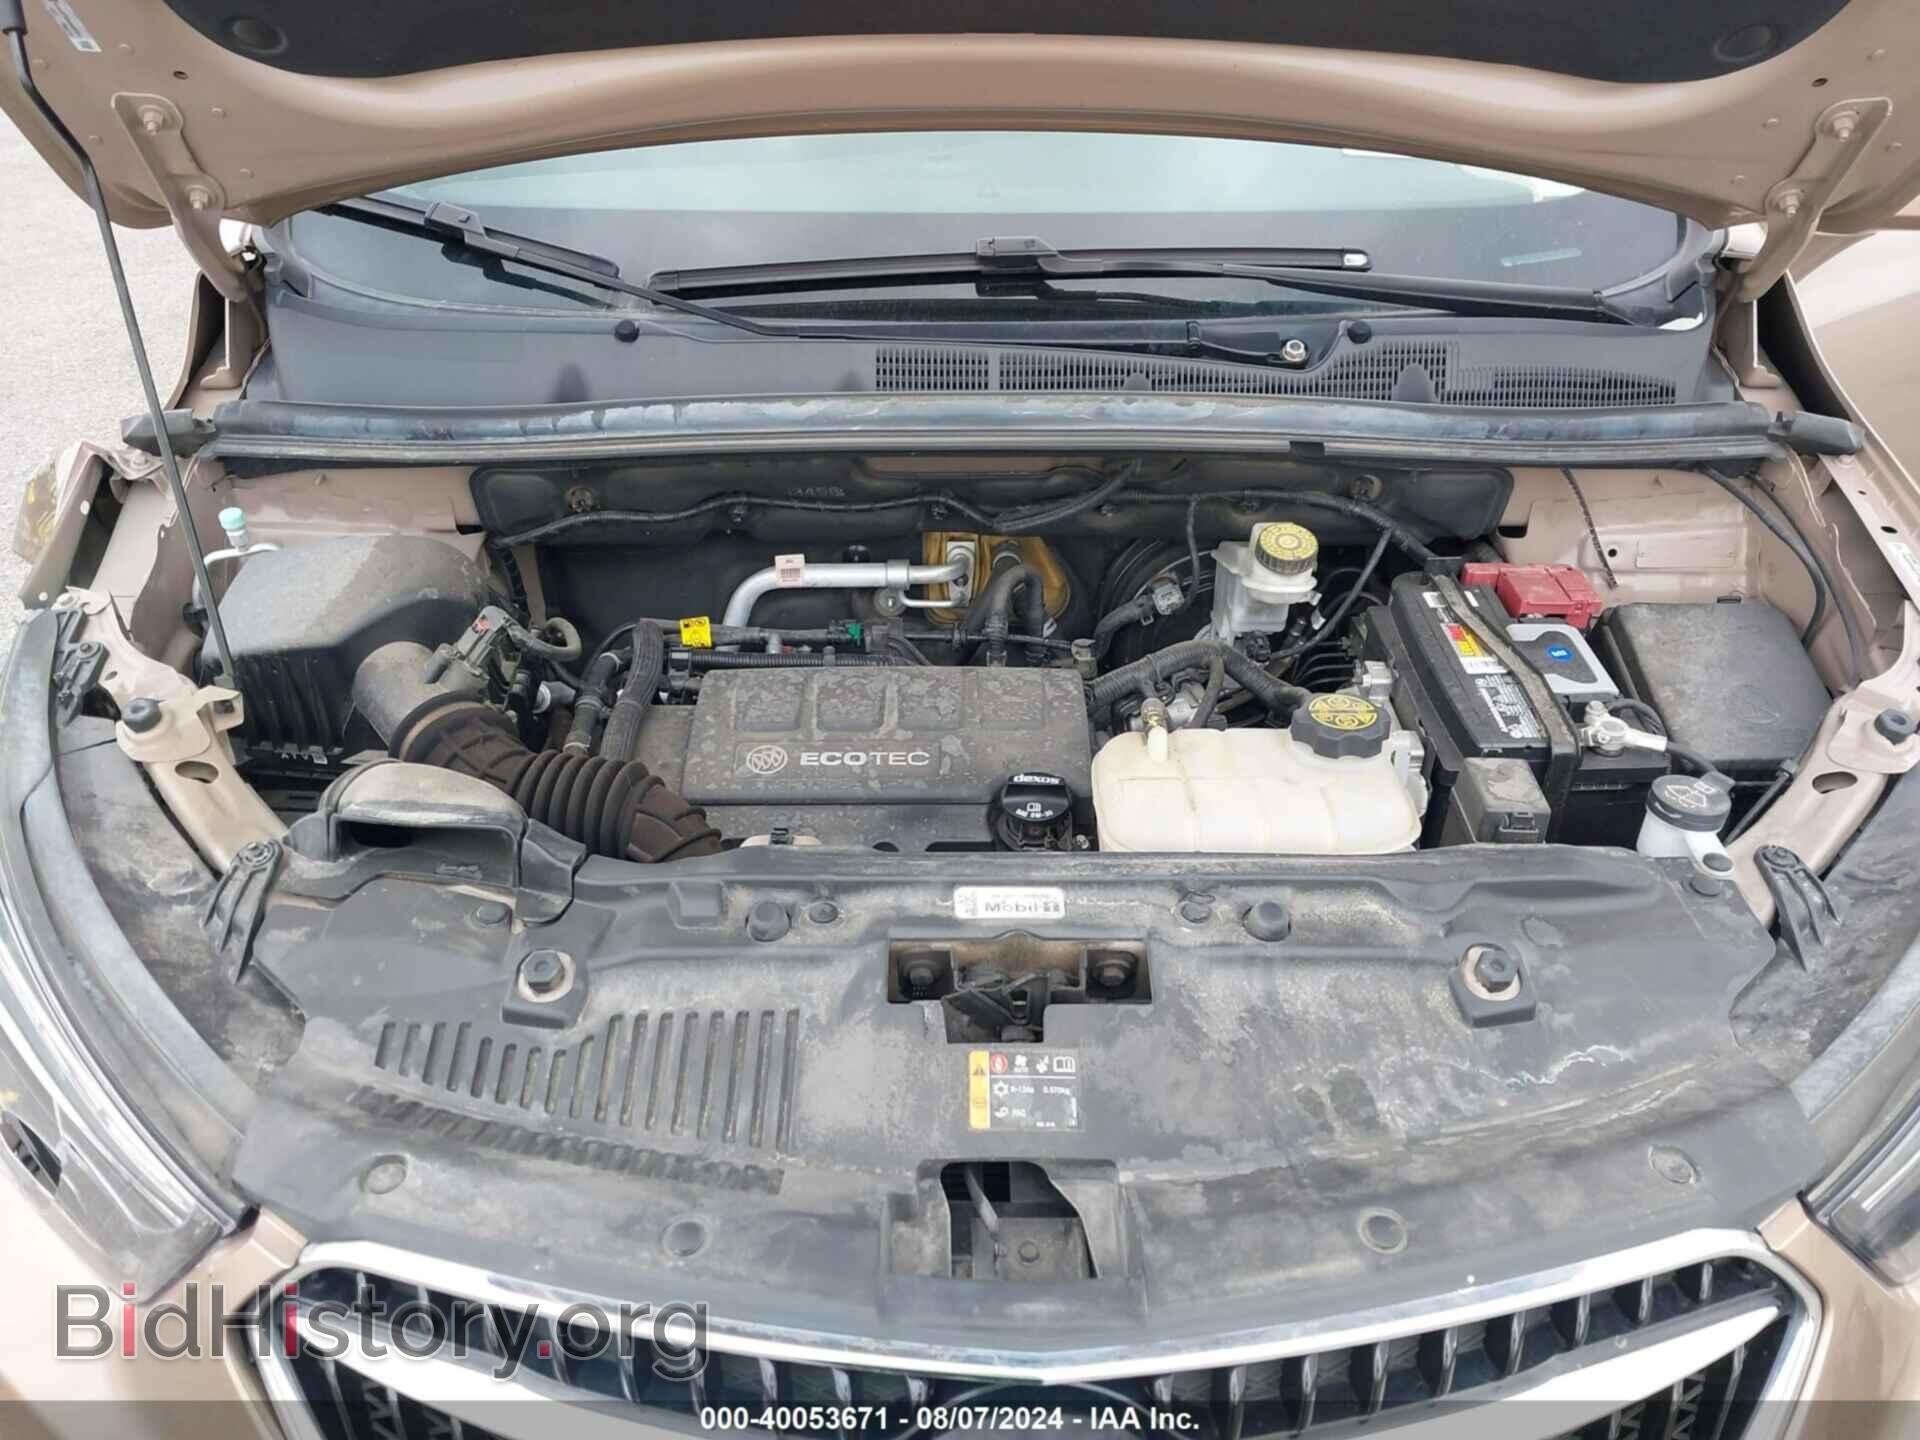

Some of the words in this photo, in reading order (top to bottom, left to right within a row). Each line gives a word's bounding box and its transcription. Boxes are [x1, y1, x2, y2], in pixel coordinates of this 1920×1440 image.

[799, 752, 931, 766] ECOTEC
[1013, 774, 1061, 784] dexos
[984, 901, 1039, 912] Mobil
